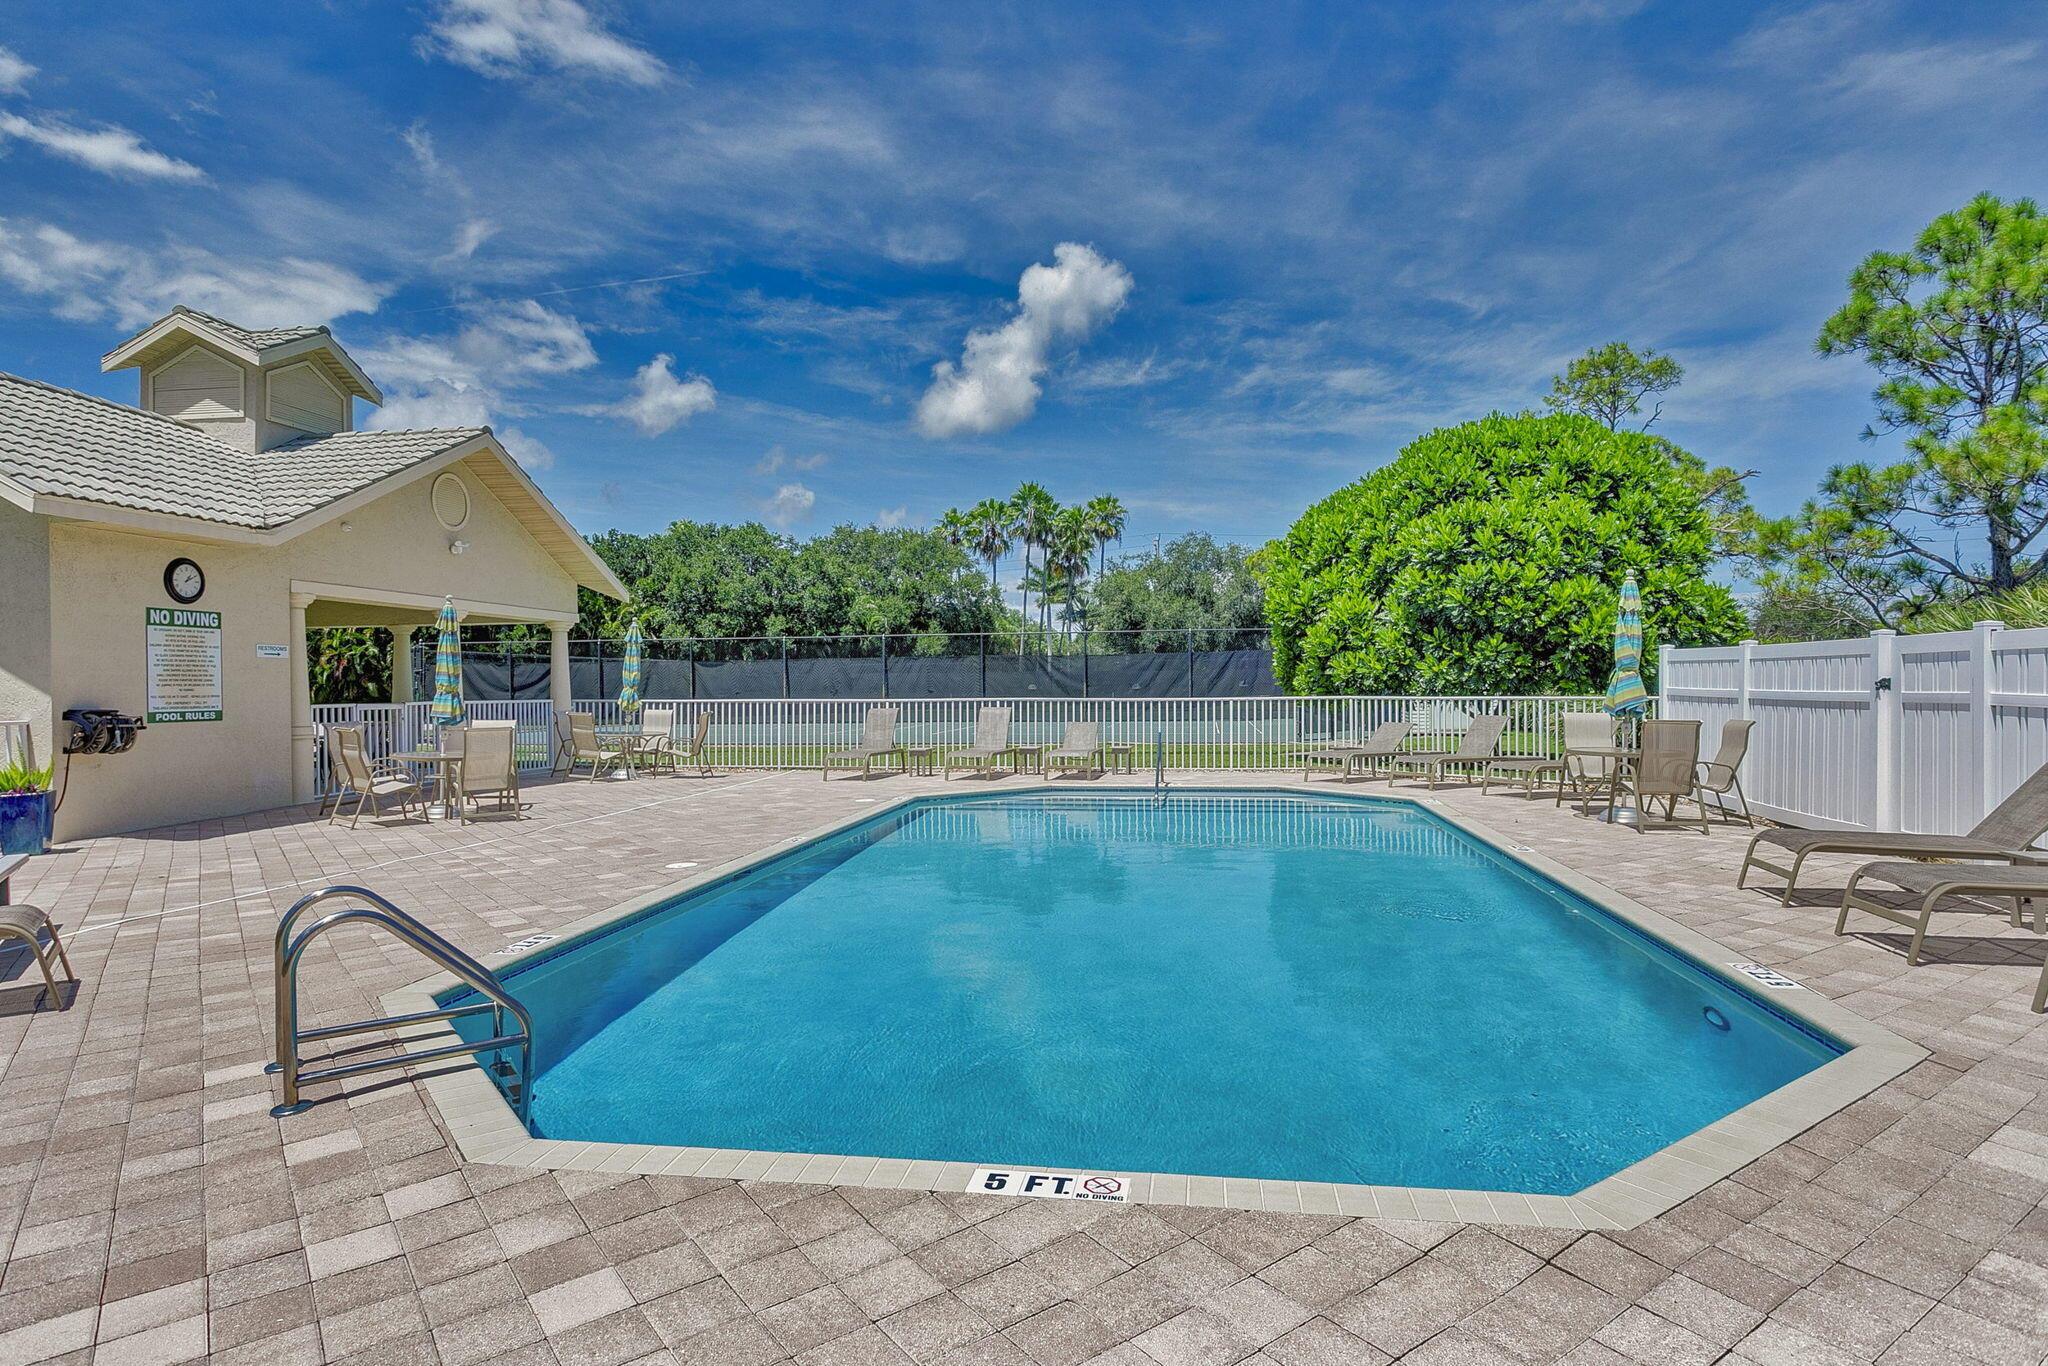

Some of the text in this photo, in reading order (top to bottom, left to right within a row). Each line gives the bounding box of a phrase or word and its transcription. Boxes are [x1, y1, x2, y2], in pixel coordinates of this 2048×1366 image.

[150, 609, 219, 627] NO DIVING
[155, 711, 216, 721] POOL RULES
[984, 1173, 1073, 1195] 5 FT.
[1076, 1192, 1124, 1202] NO DIVING
